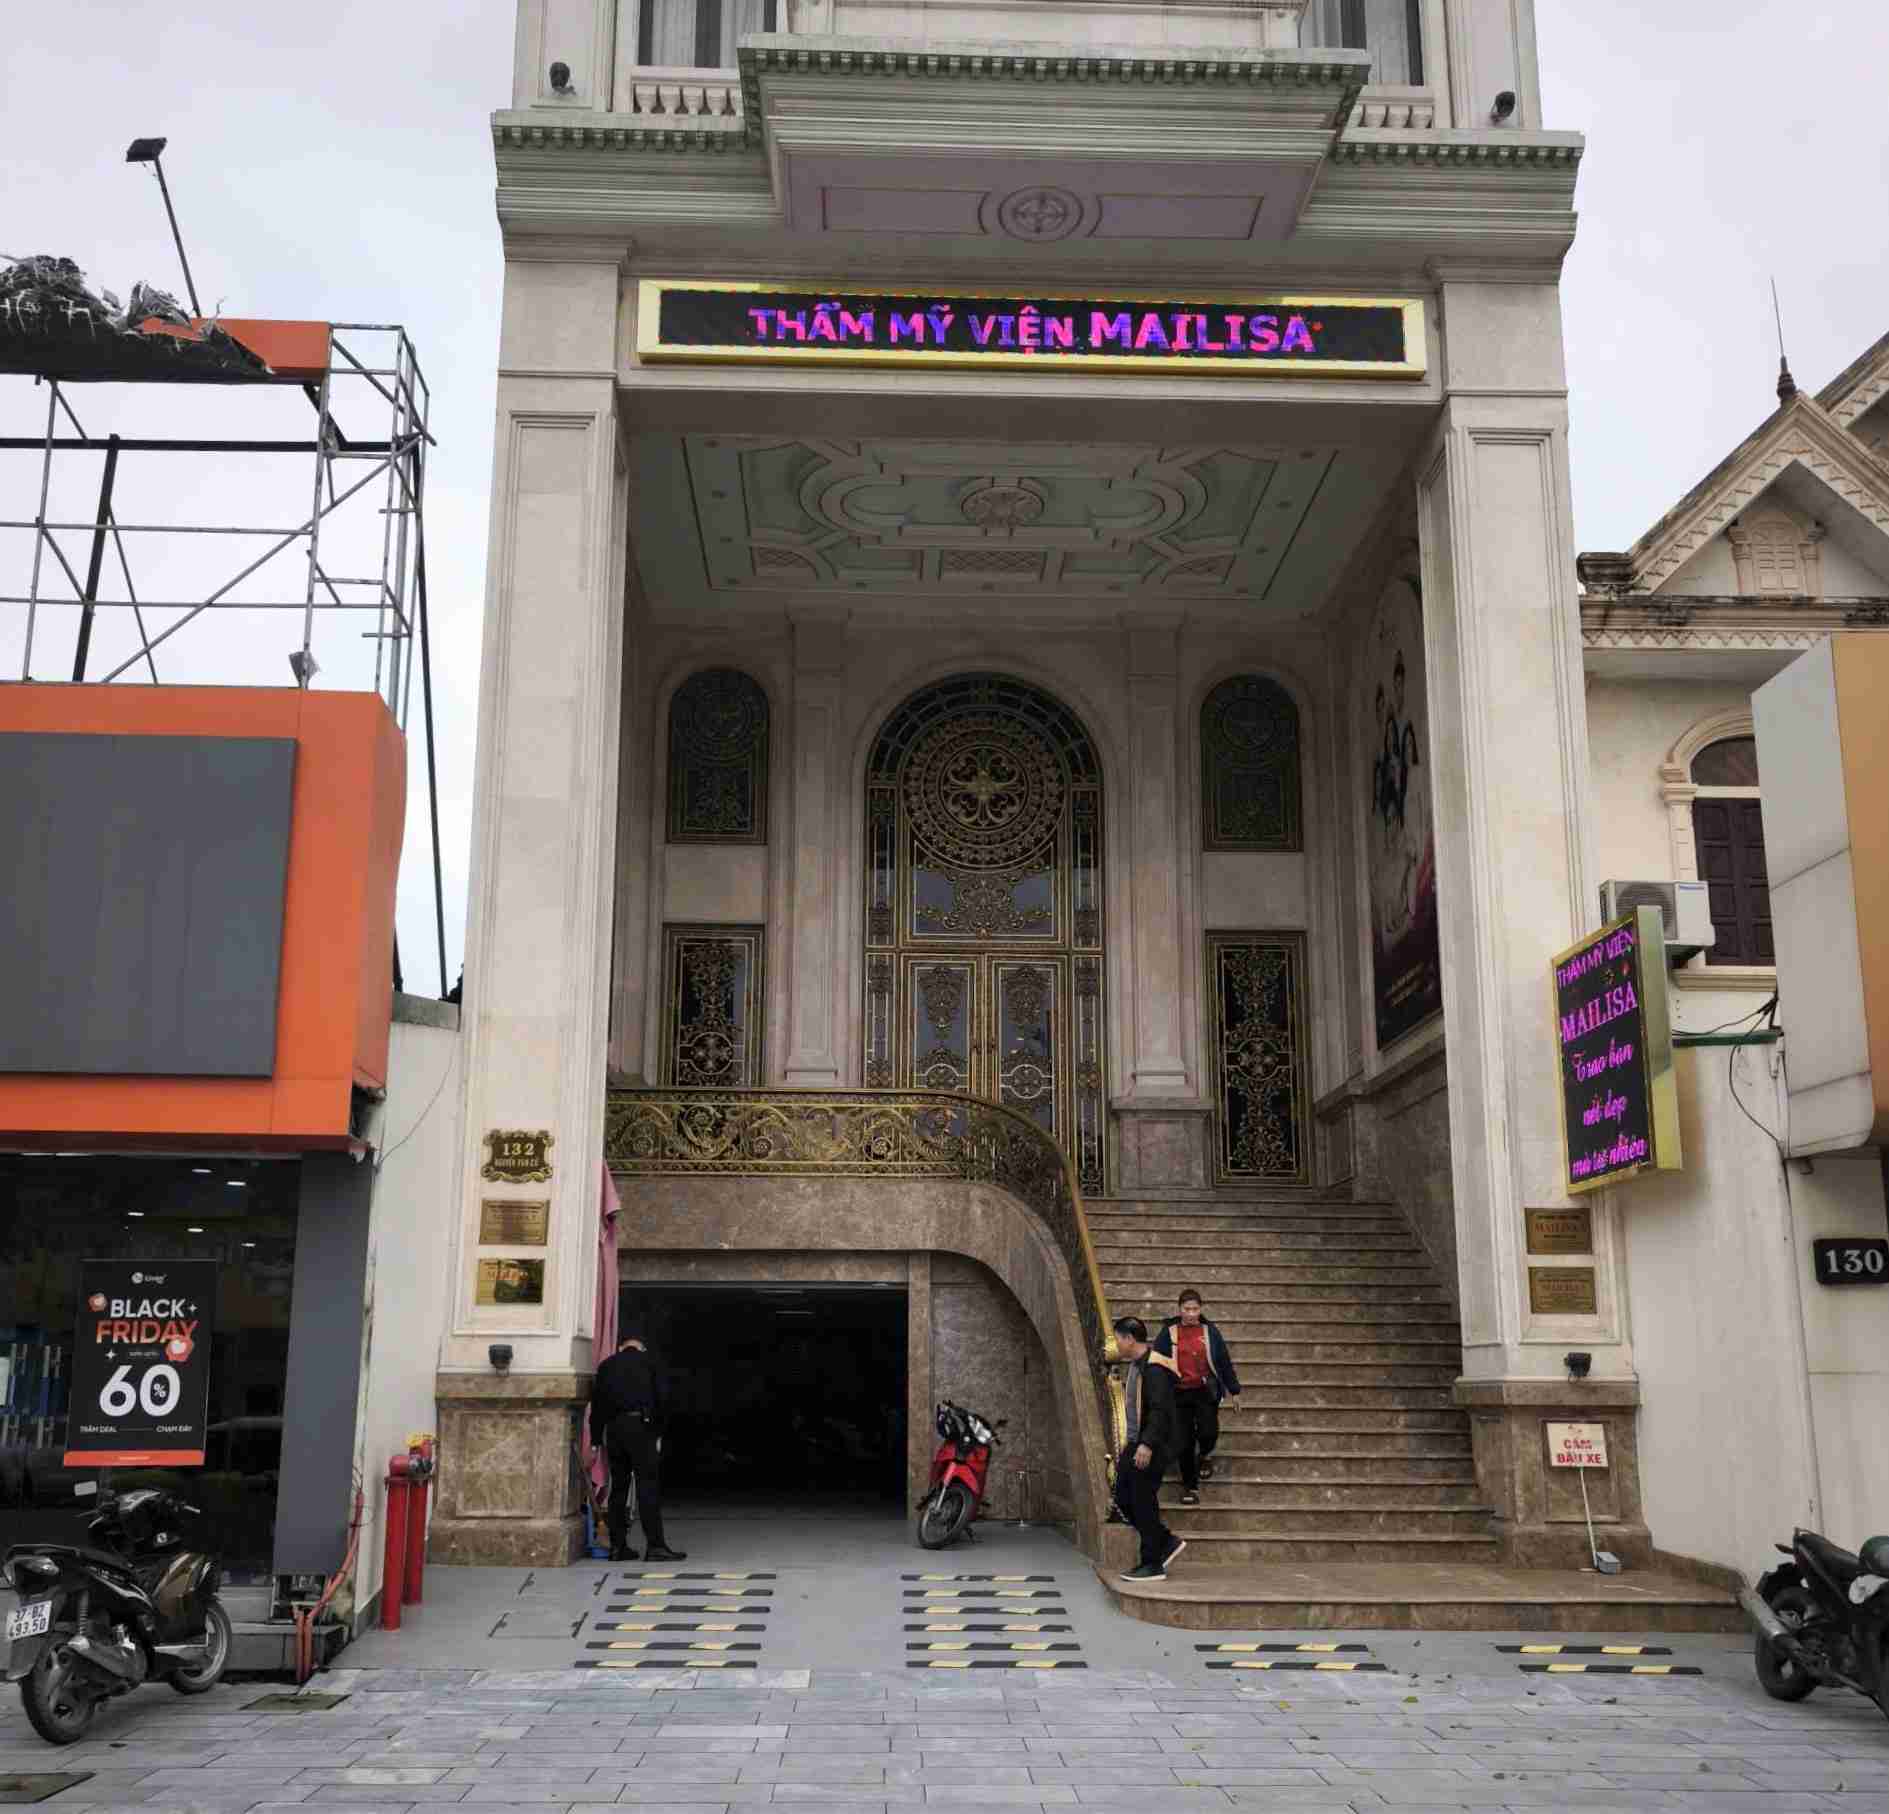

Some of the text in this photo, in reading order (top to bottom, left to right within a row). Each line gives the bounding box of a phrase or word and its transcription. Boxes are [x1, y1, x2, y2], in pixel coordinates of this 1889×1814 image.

[890, 303, 955, 344] MỸ
[968, 304, 1073, 352] VIỆN
[1090, 311, 1317, 353] MAILISA
[1560, 981, 1638, 1042] MAILISA
[503, 1143, 534, 1156] 132
[1825, 1248, 1884, 1274] 130
[110, 1298, 186, 1318] BLACK
[95, 1320, 200, 1344] FRIDAY
[1587, 1453, 1602, 1464] XE
